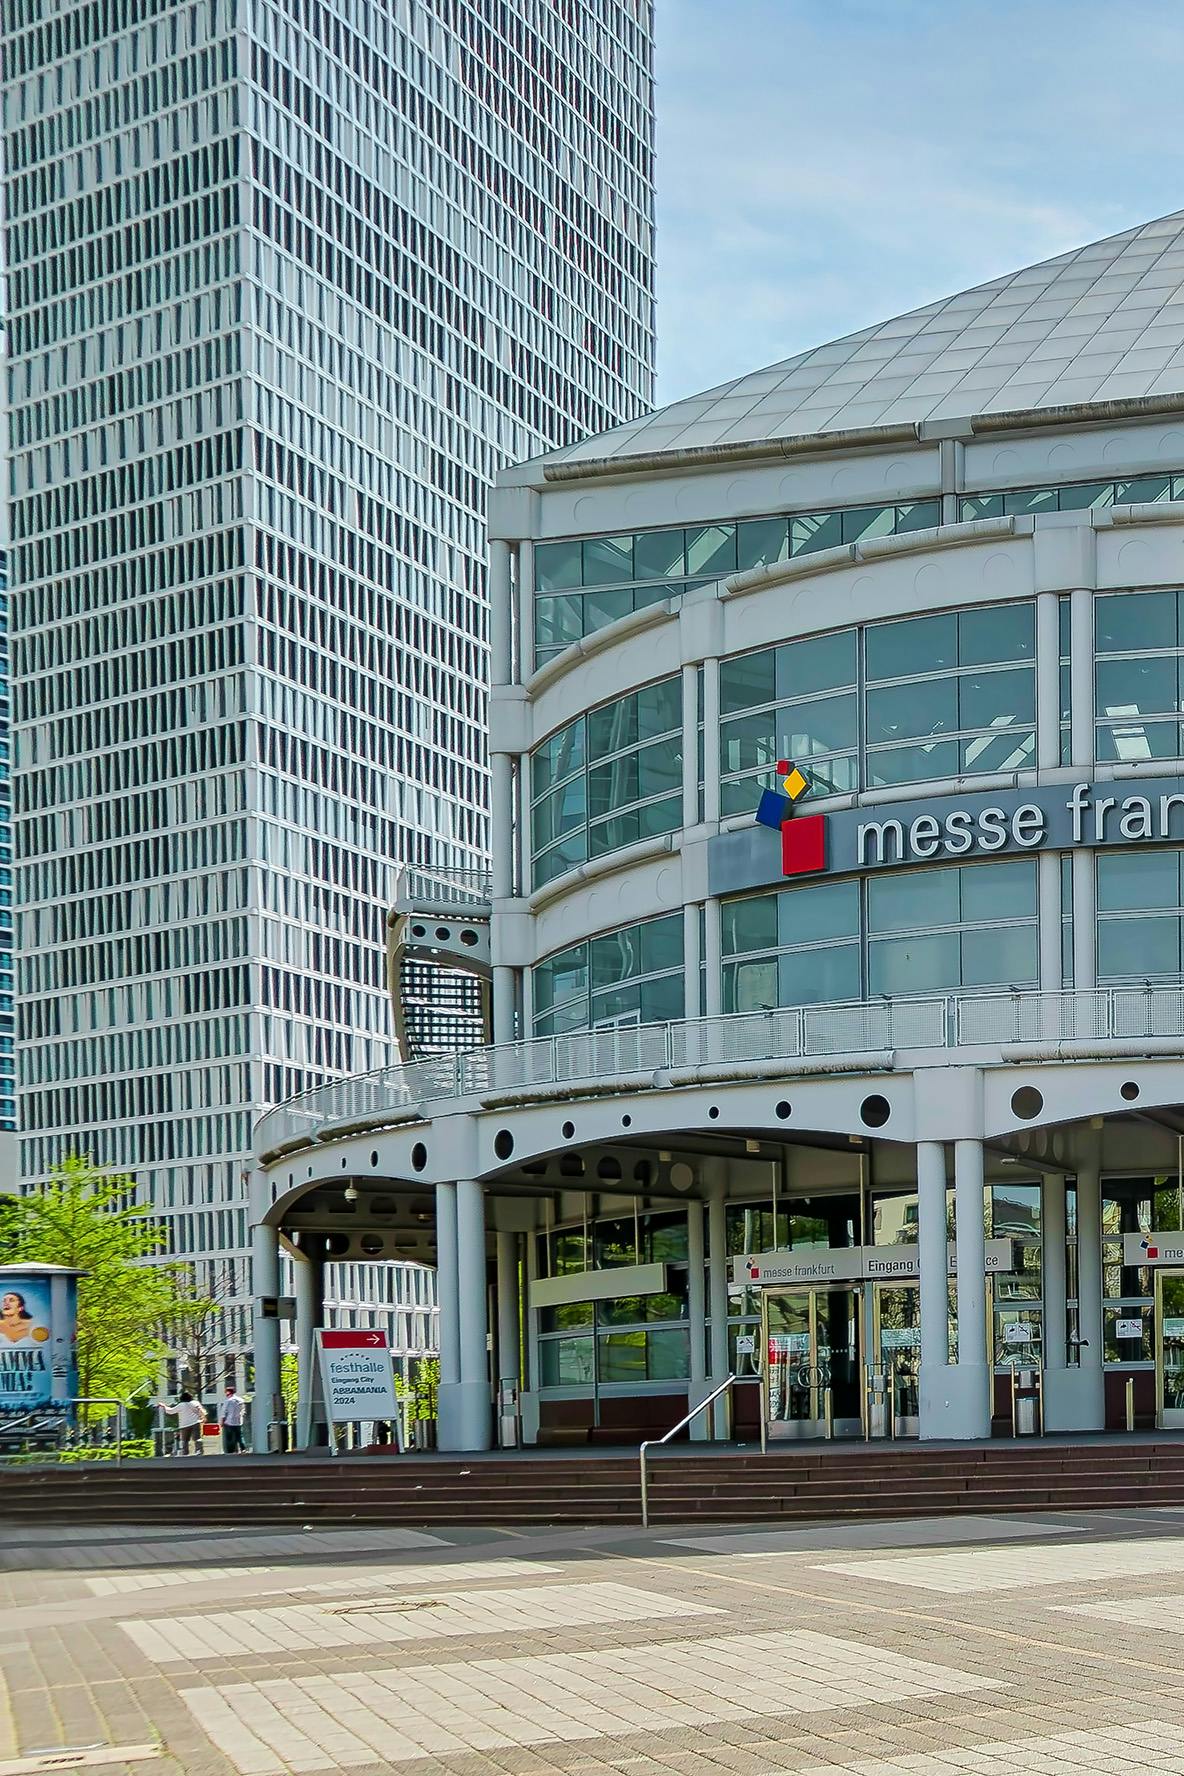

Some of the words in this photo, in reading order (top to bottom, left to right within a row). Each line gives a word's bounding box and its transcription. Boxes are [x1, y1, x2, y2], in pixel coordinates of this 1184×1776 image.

[857, 802, 1046, 865] messe
[763, 1267, 792, 1279] messe
[794, 1263, 835, 1277] frankfurt
[868, 1259, 914, 1273] Eingang
[329, 1362, 385, 1374] festhalle
[332, 1386, 388, 1395] ABBAMANIA
[334, 1397, 356, 1405] 2024
